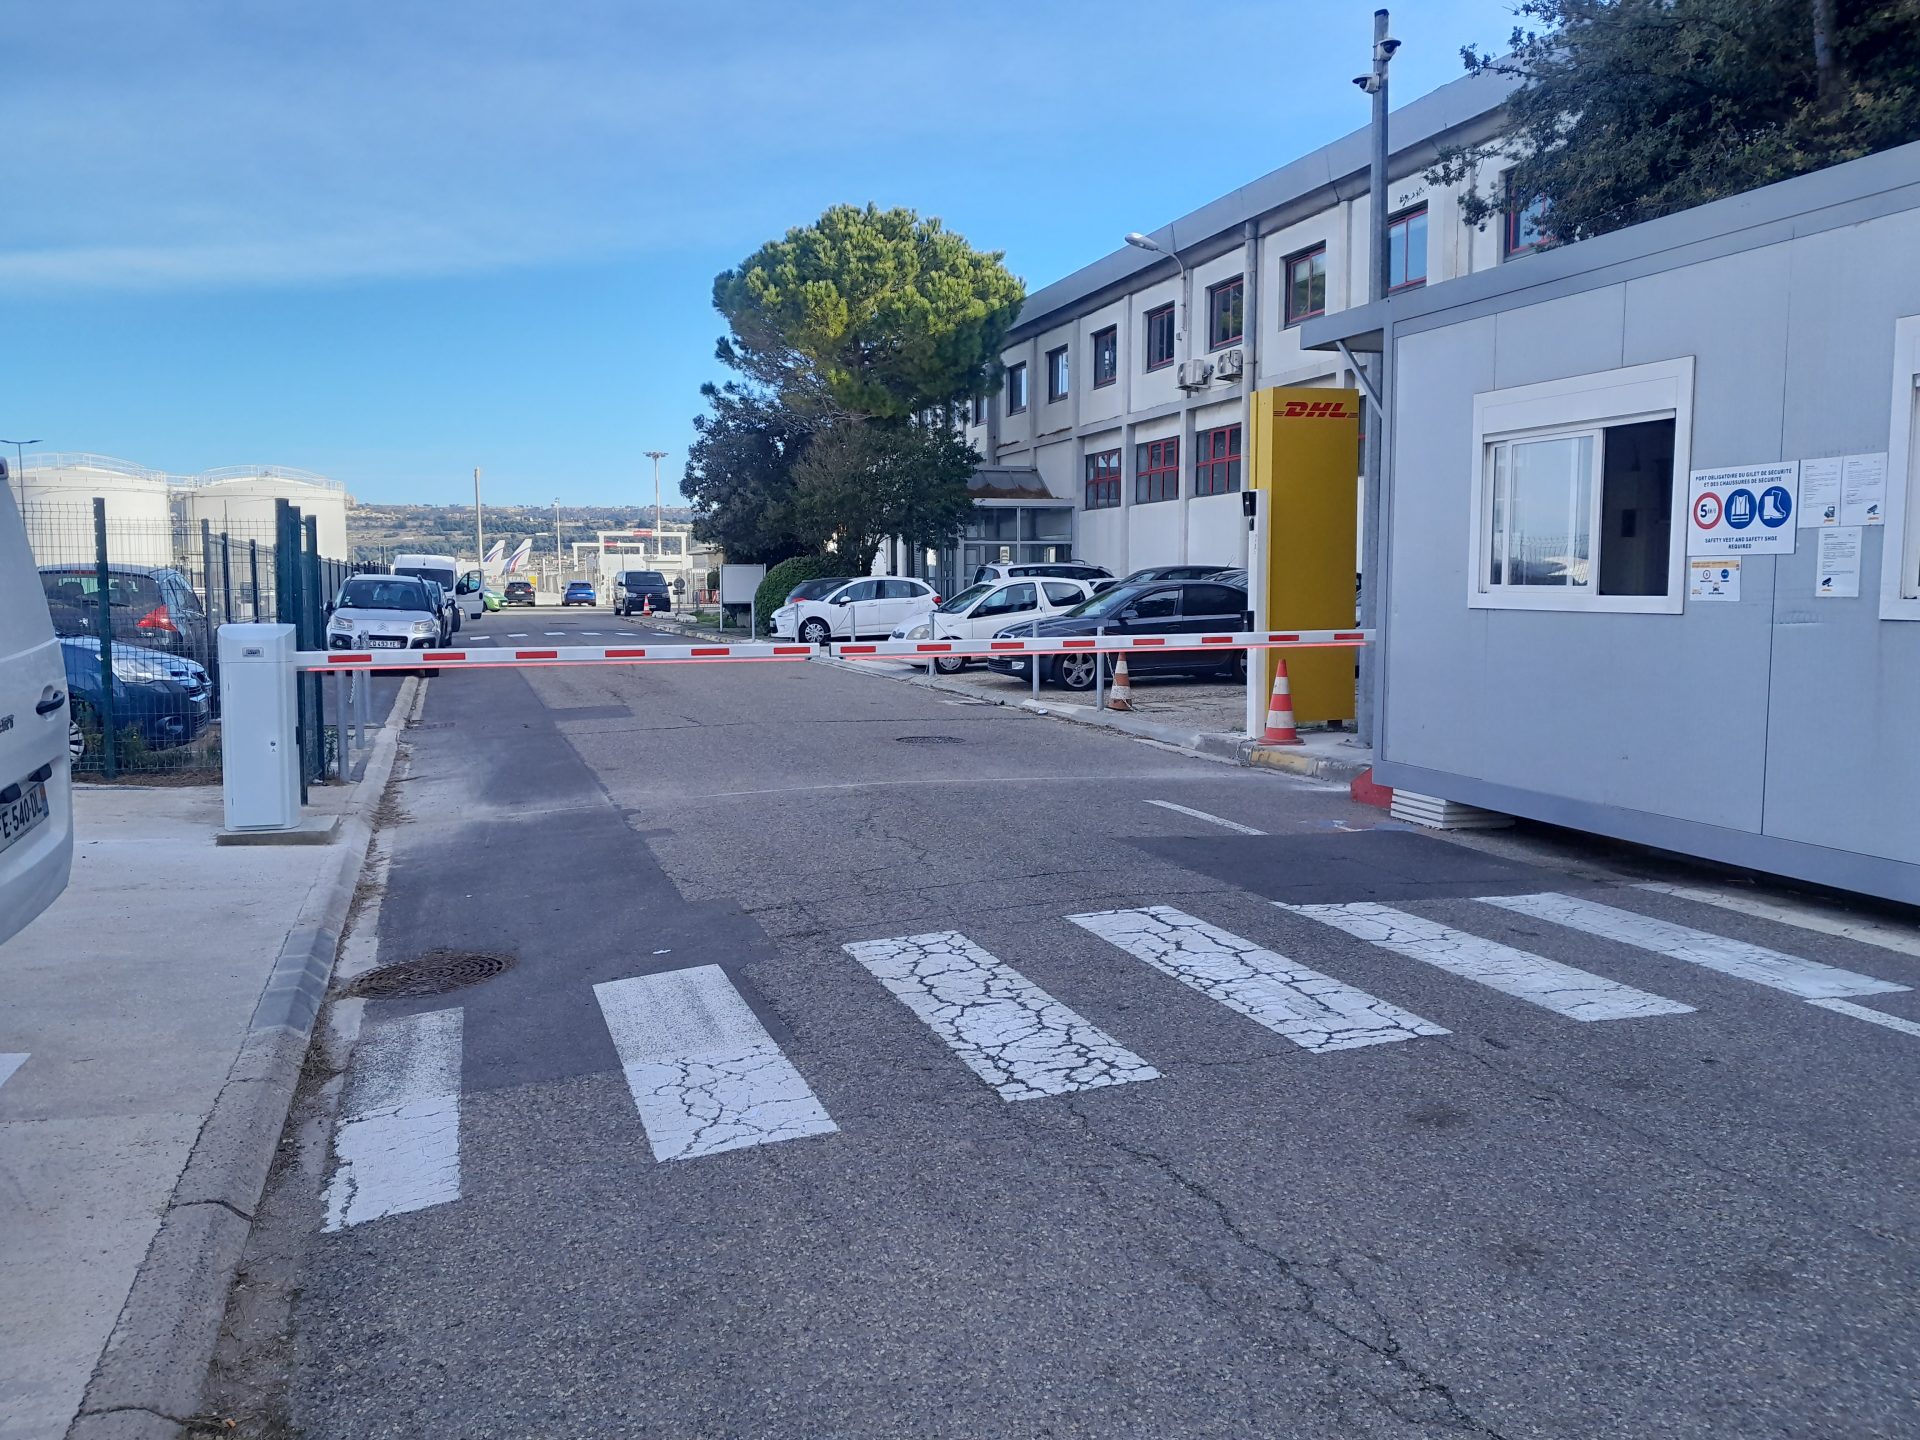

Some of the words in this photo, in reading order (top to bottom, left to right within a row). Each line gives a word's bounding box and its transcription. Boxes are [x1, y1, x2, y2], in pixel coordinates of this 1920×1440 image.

[1284, 401, 1347, 418] DHL
[1708, 472, 1738, 480] OBLIGATOIRE
[1719, 478, 1750, 486] CHAUSSURES
[1700, 504, 1708, 518] 5
[0, 790, 42, 839] E-540-DL
